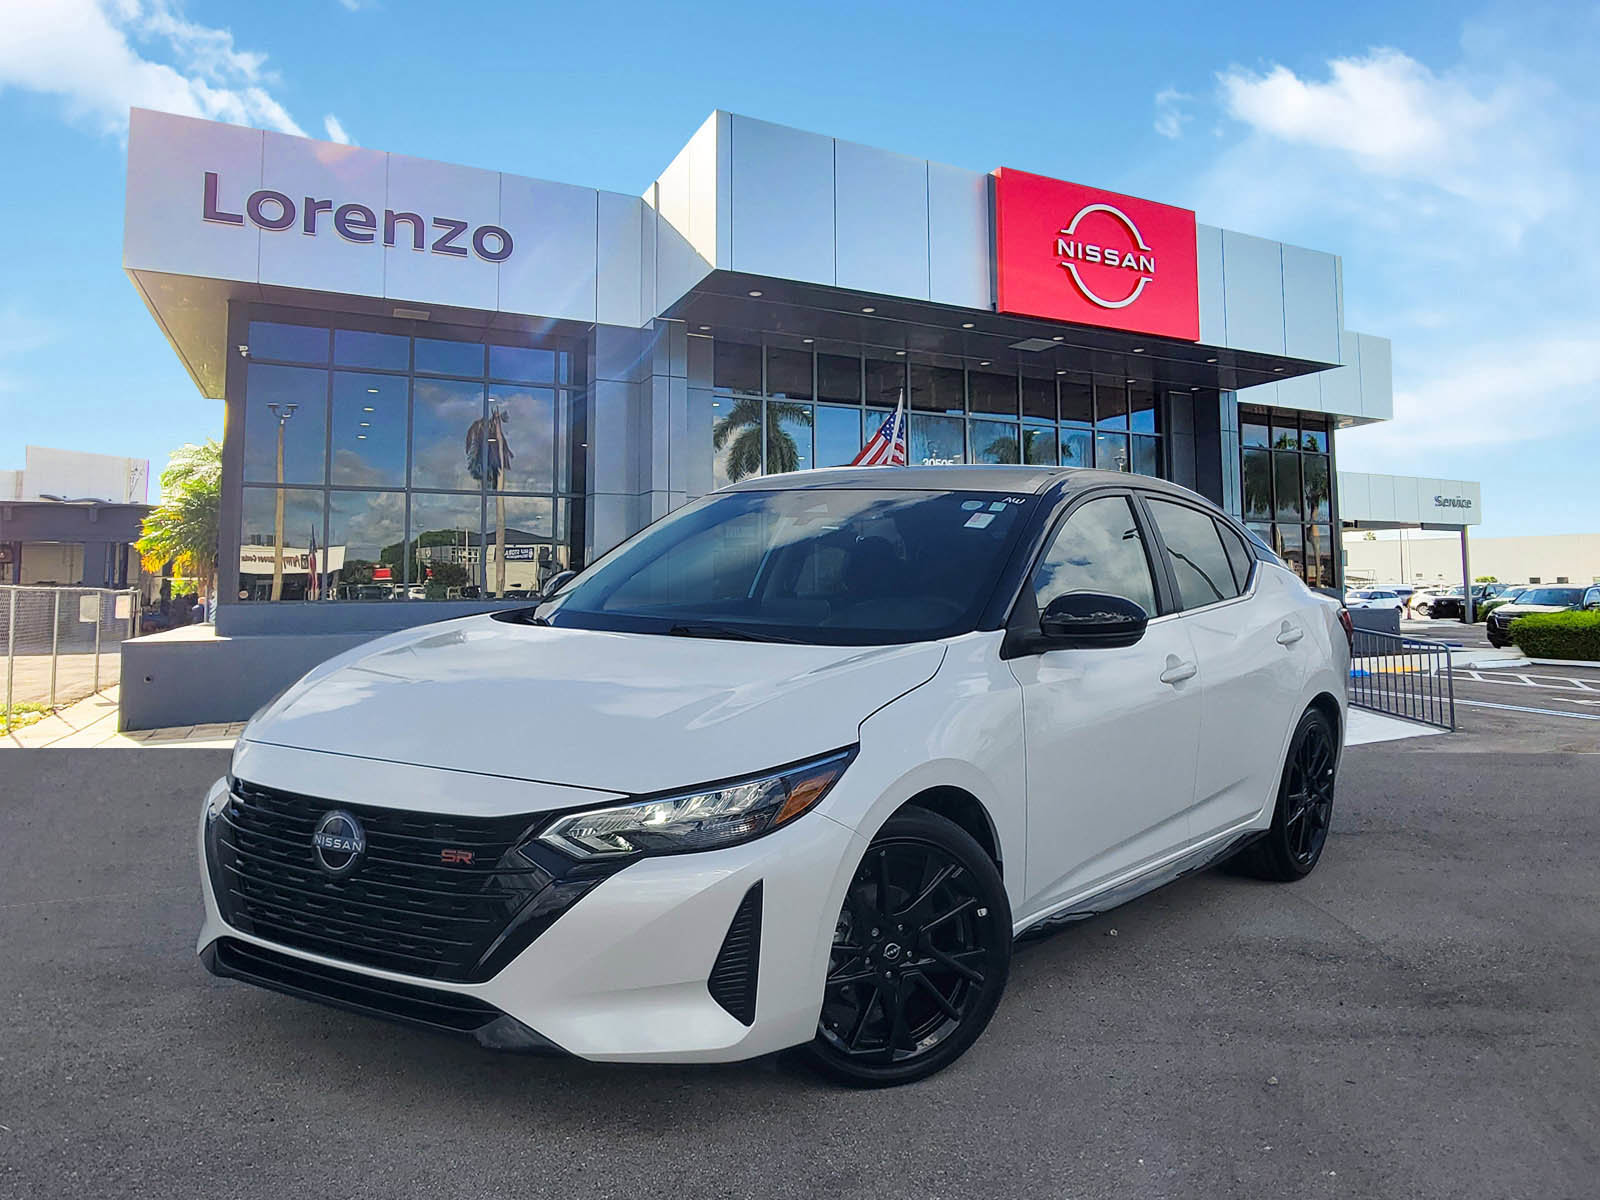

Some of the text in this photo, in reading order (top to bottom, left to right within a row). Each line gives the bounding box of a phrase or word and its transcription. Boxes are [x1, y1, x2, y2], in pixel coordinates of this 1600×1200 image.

[203, 171, 514, 262] Lorenzo
[1057, 238, 1155, 273] NISSAN
[1433, 495, 1472, 508] Service
[314, 834, 362, 851] NISSAN
[440, 848, 475, 864] SR
